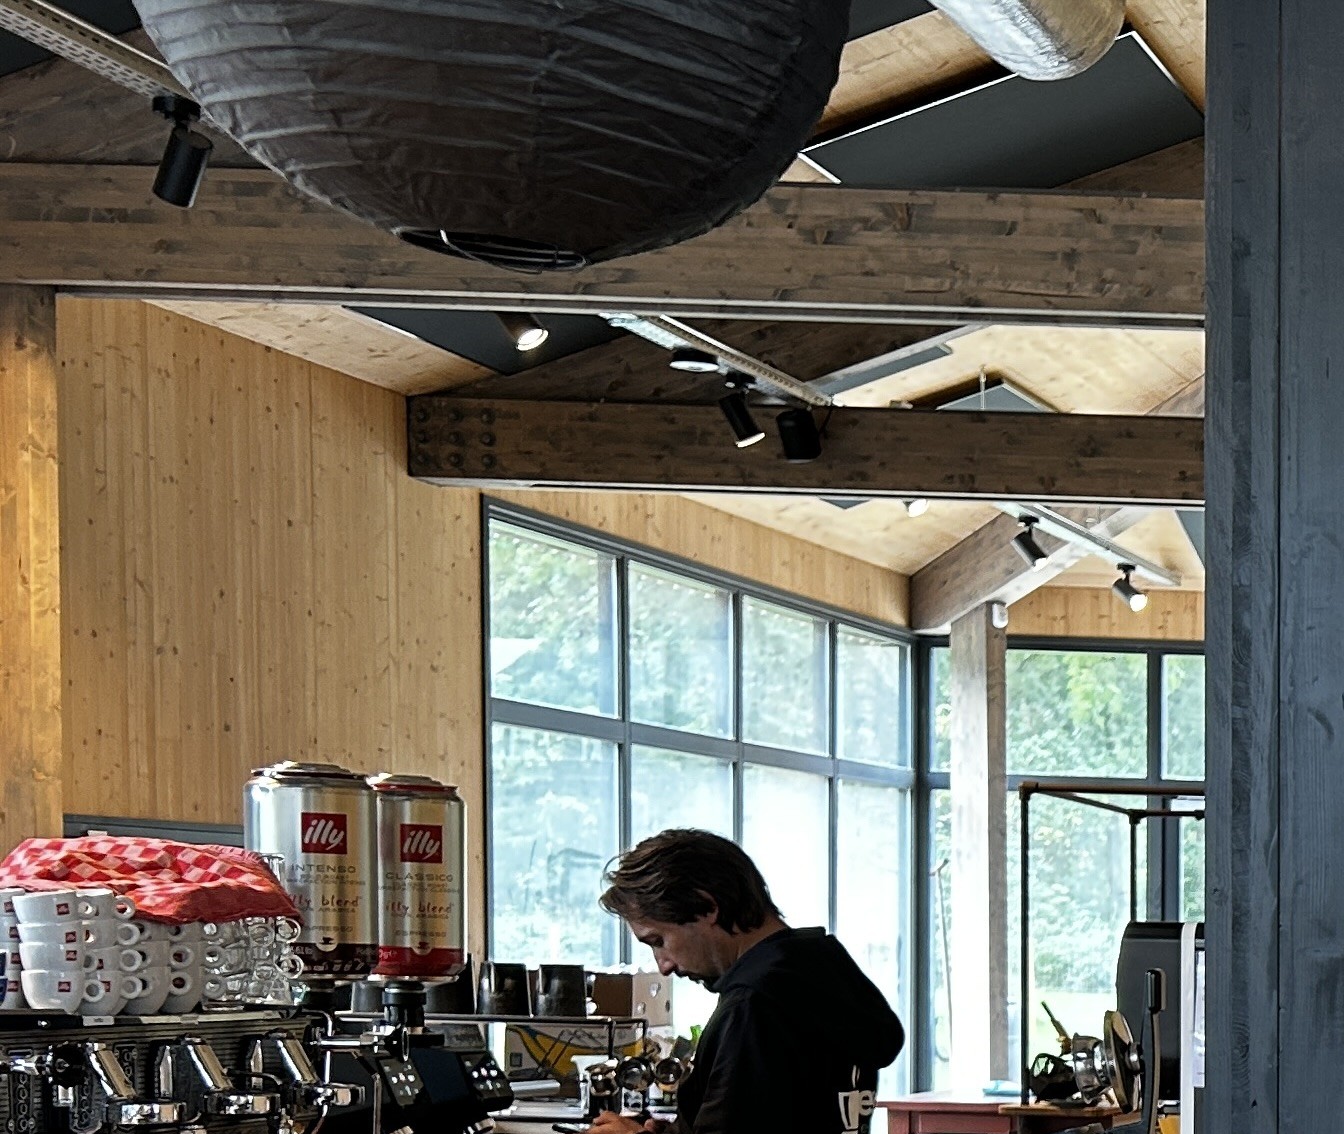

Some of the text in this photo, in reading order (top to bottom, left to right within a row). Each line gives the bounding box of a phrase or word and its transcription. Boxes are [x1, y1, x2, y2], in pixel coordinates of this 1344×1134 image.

[303, 818, 345, 851] illy
[403, 829, 440, 860] illy
[291, 864, 356, 873] INTENSO
[385, 872, 453, 882] CLASSICO
[321, 894, 359, 907] blend
